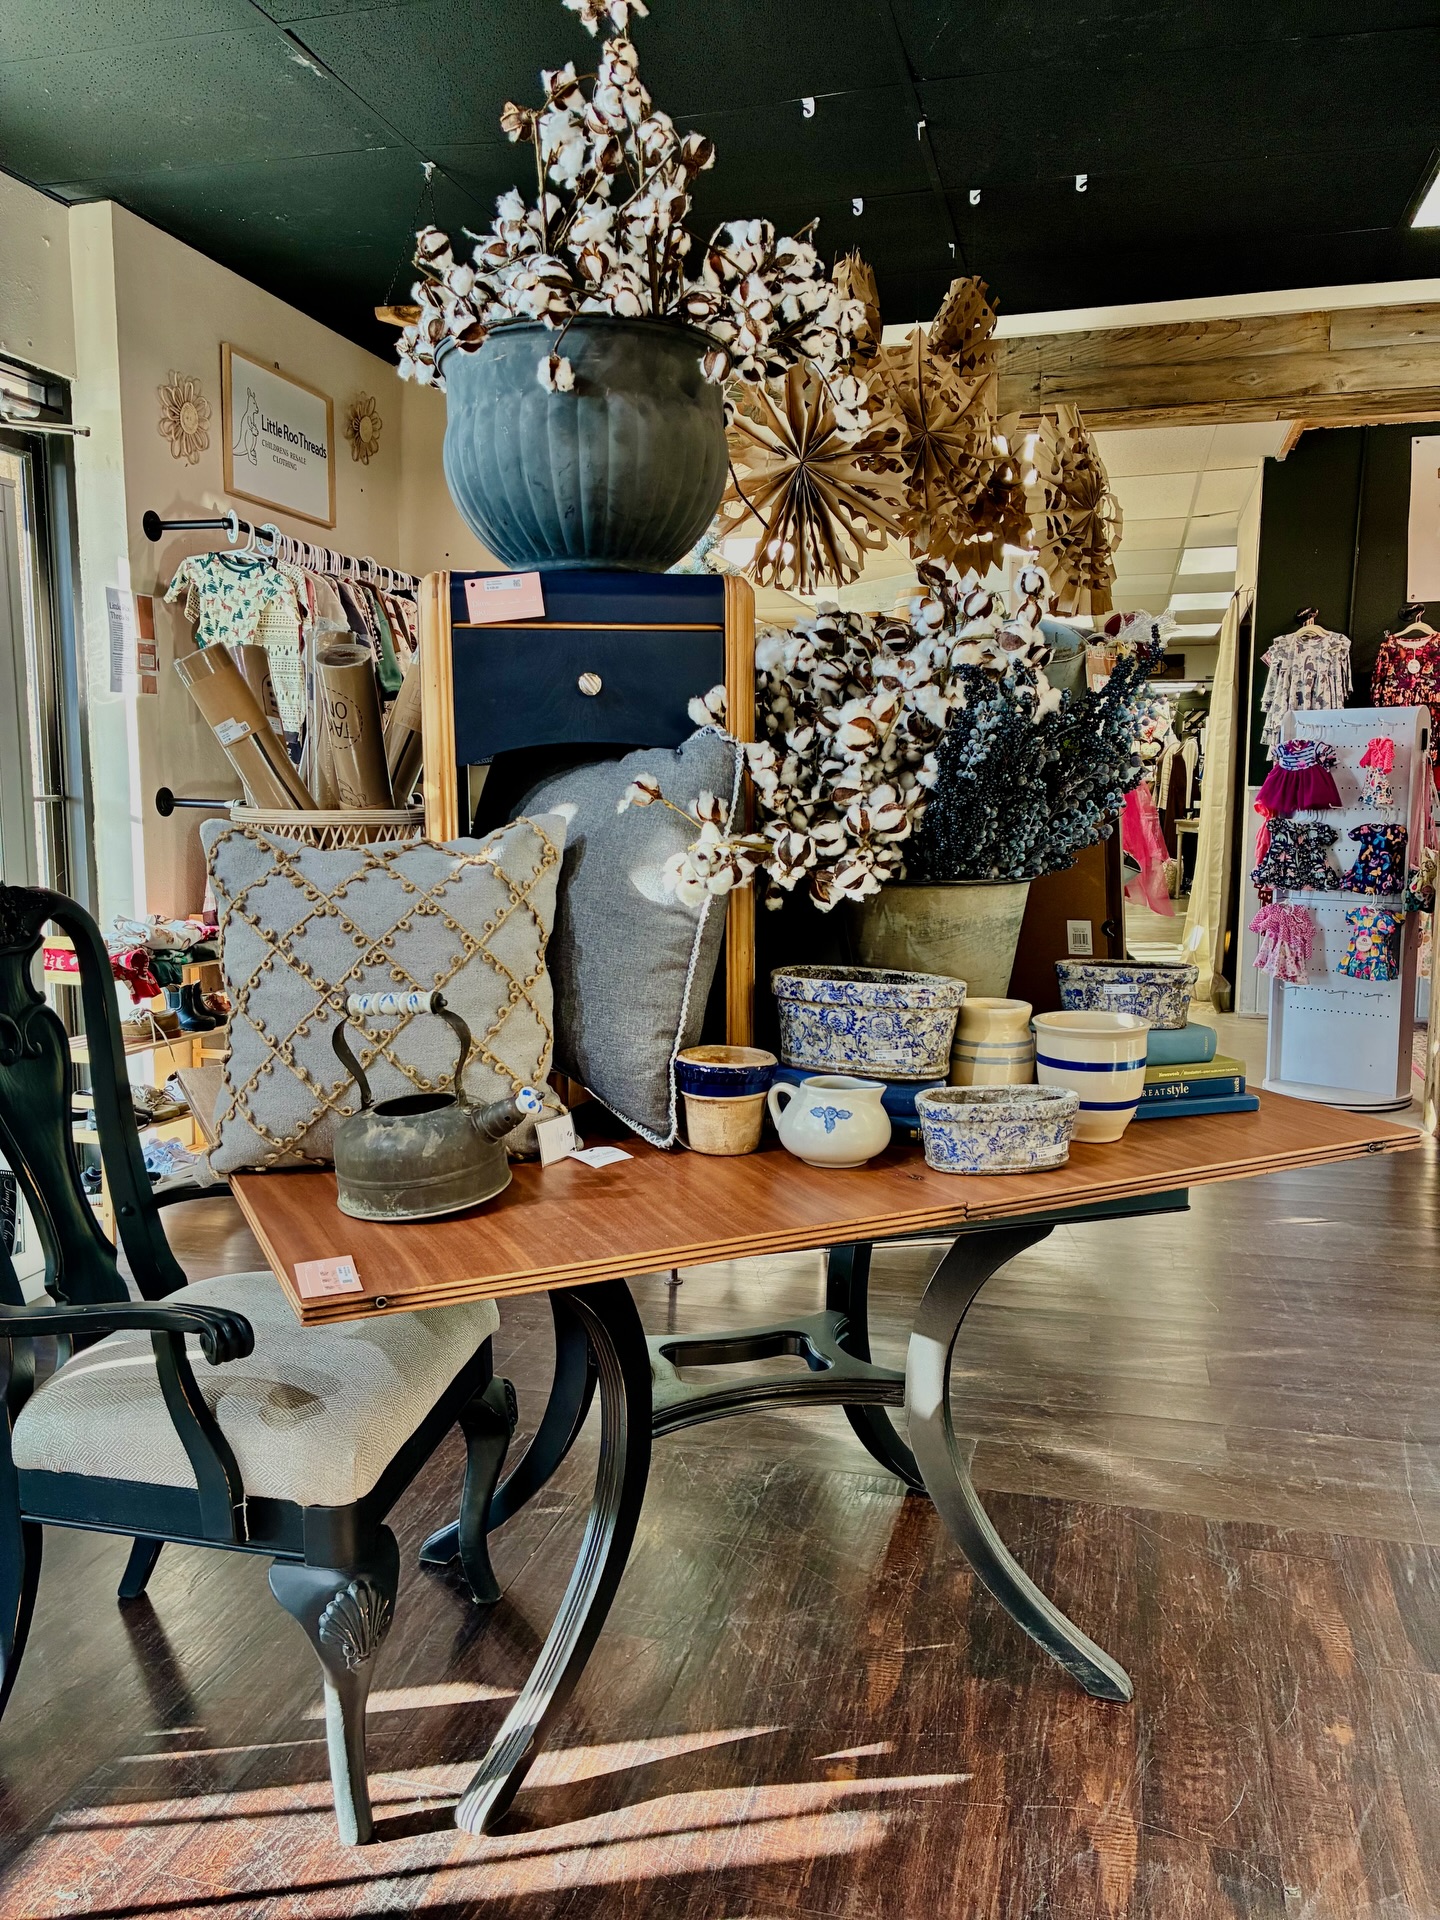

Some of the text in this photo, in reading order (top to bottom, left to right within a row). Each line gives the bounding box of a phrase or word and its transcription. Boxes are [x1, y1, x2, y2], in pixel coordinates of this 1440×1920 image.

[262, 414, 327, 459] Little Roo Threads
[262, 439, 307, 465] CHILDRENS RESALE
[273, 455, 297, 471] CLOTHING
[1142, 1082, 1190, 1098] REAT style
